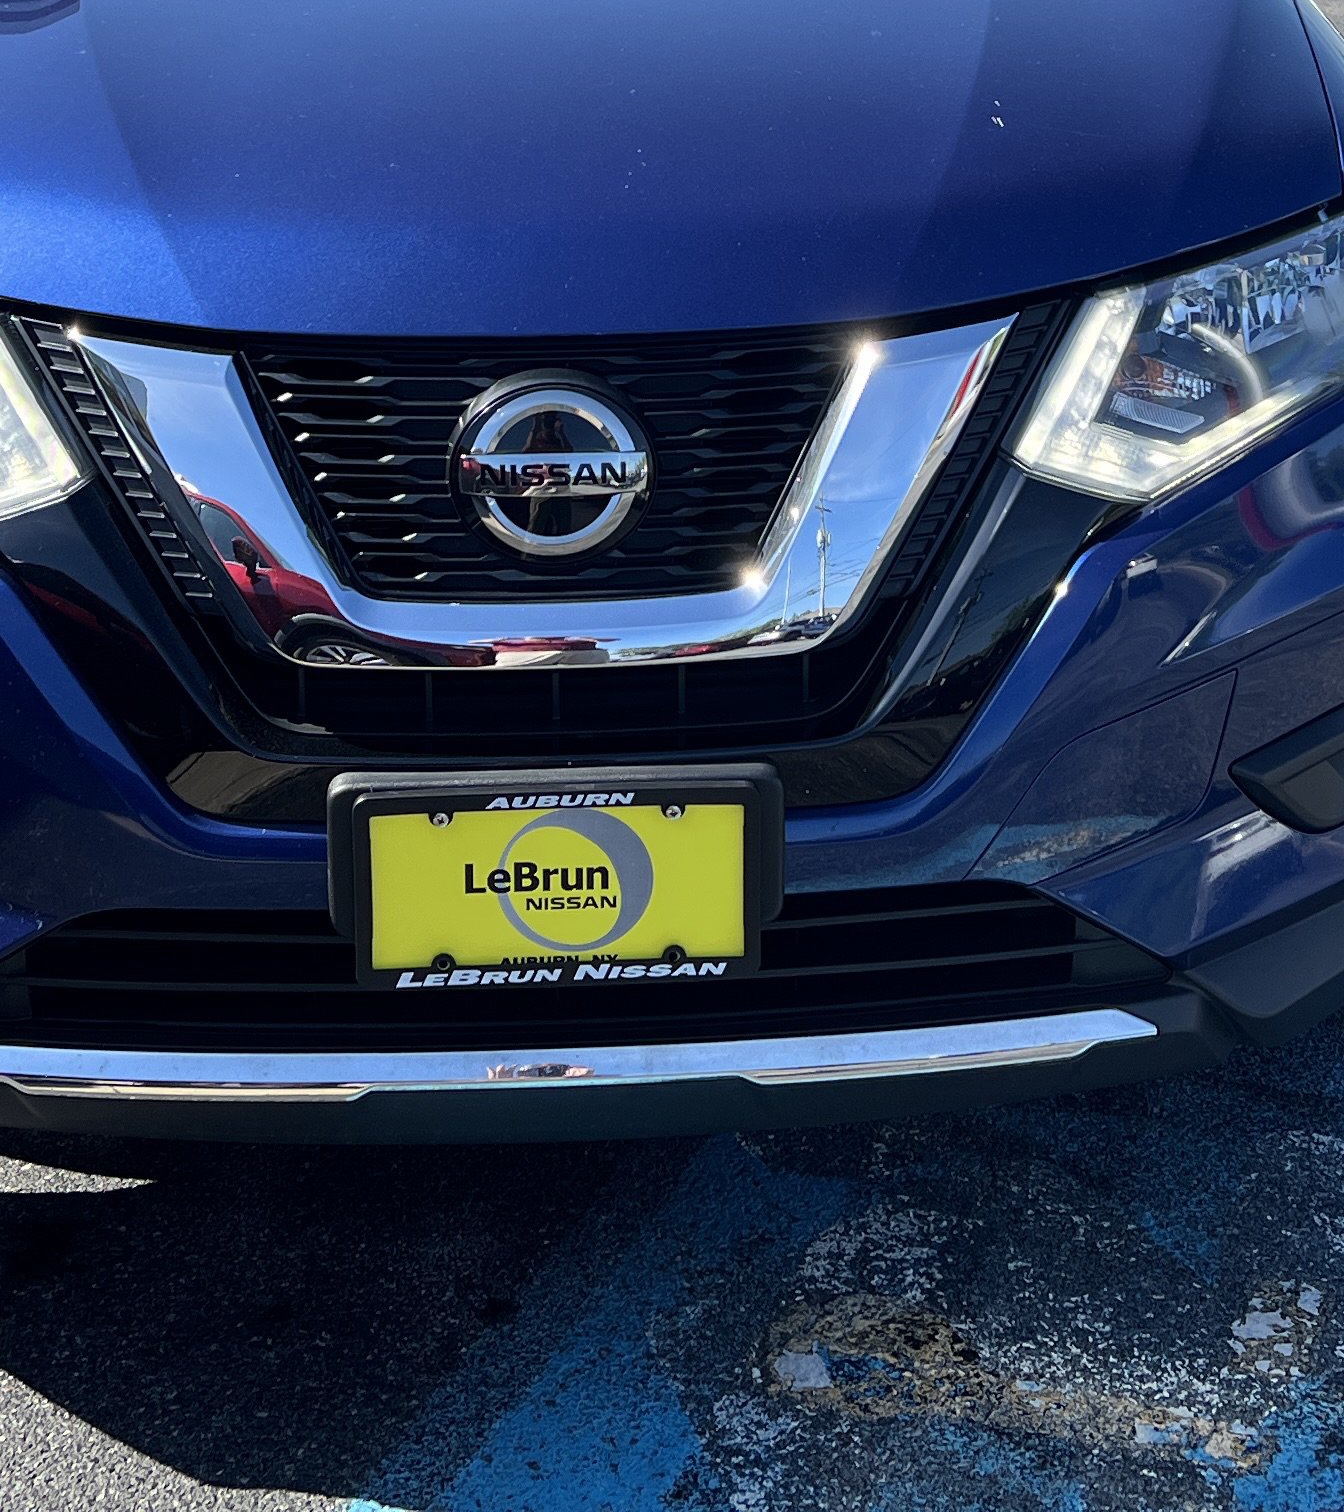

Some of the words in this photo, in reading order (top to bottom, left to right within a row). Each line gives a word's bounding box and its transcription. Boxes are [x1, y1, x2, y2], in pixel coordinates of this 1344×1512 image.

[480, 461, 627, 487] NISSAN
[485, 792, 636, 810] AUBURN
[464, 861, 610, 894] LeBrun
[526, 896, 618, 911] NISSAN
